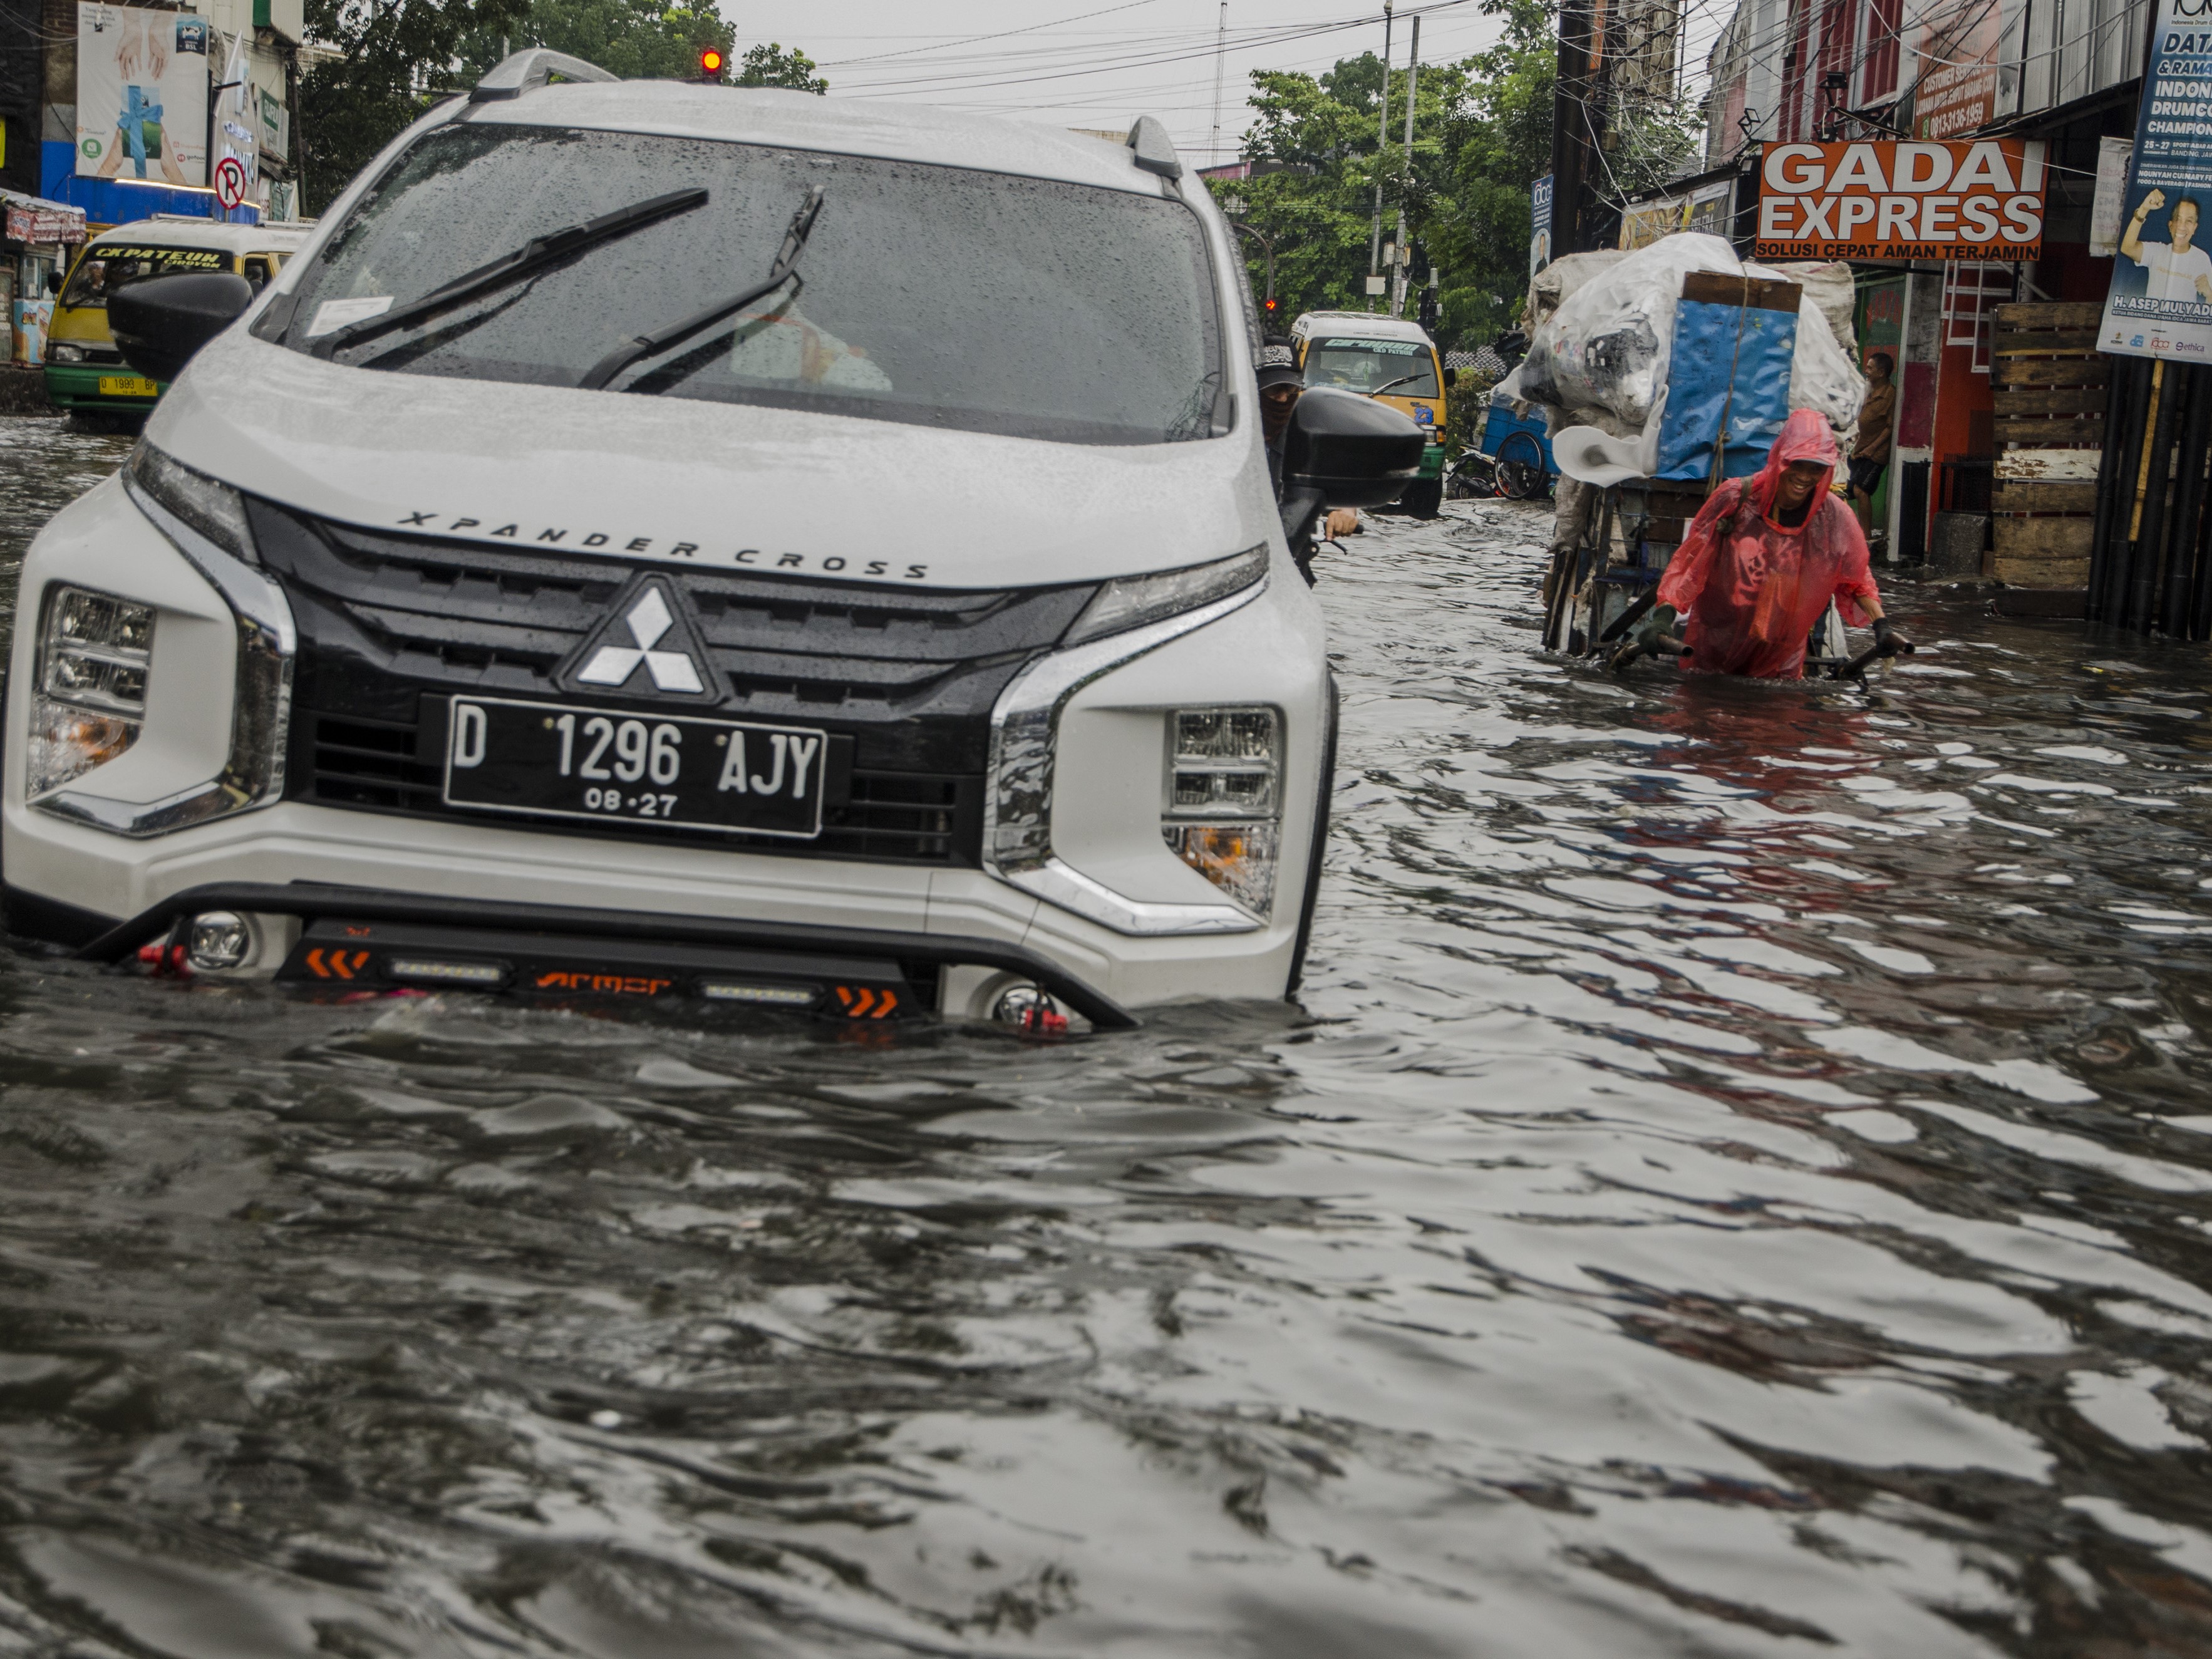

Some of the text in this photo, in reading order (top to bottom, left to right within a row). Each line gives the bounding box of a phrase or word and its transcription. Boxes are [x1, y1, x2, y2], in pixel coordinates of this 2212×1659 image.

[1924, 67, 1955, 94] CUSTOMER
[1955, 58, 1980, 82] SERVICE
[2158, 61, 2170, 75] &
[1916, 95, 1934, 116] LAYANAN
[1935, 91, 1948, 109] ANTAR
[1964, 78, 1983, 99] BARANG
[1930, 101, 1983, 137] 0813-3136-1959
[2144, 140, 2155, 148] 25
[2160, 141, 2170, 150] 27
[1764, 141, 2047, 194] GADAI
[2139, 170, 2171, 178] NGUNYAH
[1759, 195, 2042, 242] EXPRESS
[1757, 243, 2039, 259] SOLUSI CEPAT AMAN TERJAMIN
[2114, 296, 2126, 308] H.
[2128, 297, 2159, 312] ASEP
[2183, 342, 2204, 352] ethica
[101, 378, 106, 388] D
[1414, 407, 1434, 424] 23
[398, 510, 929, 579] XPANDER CROSS
[453, 704, 819, 799] D 1296 AJY
